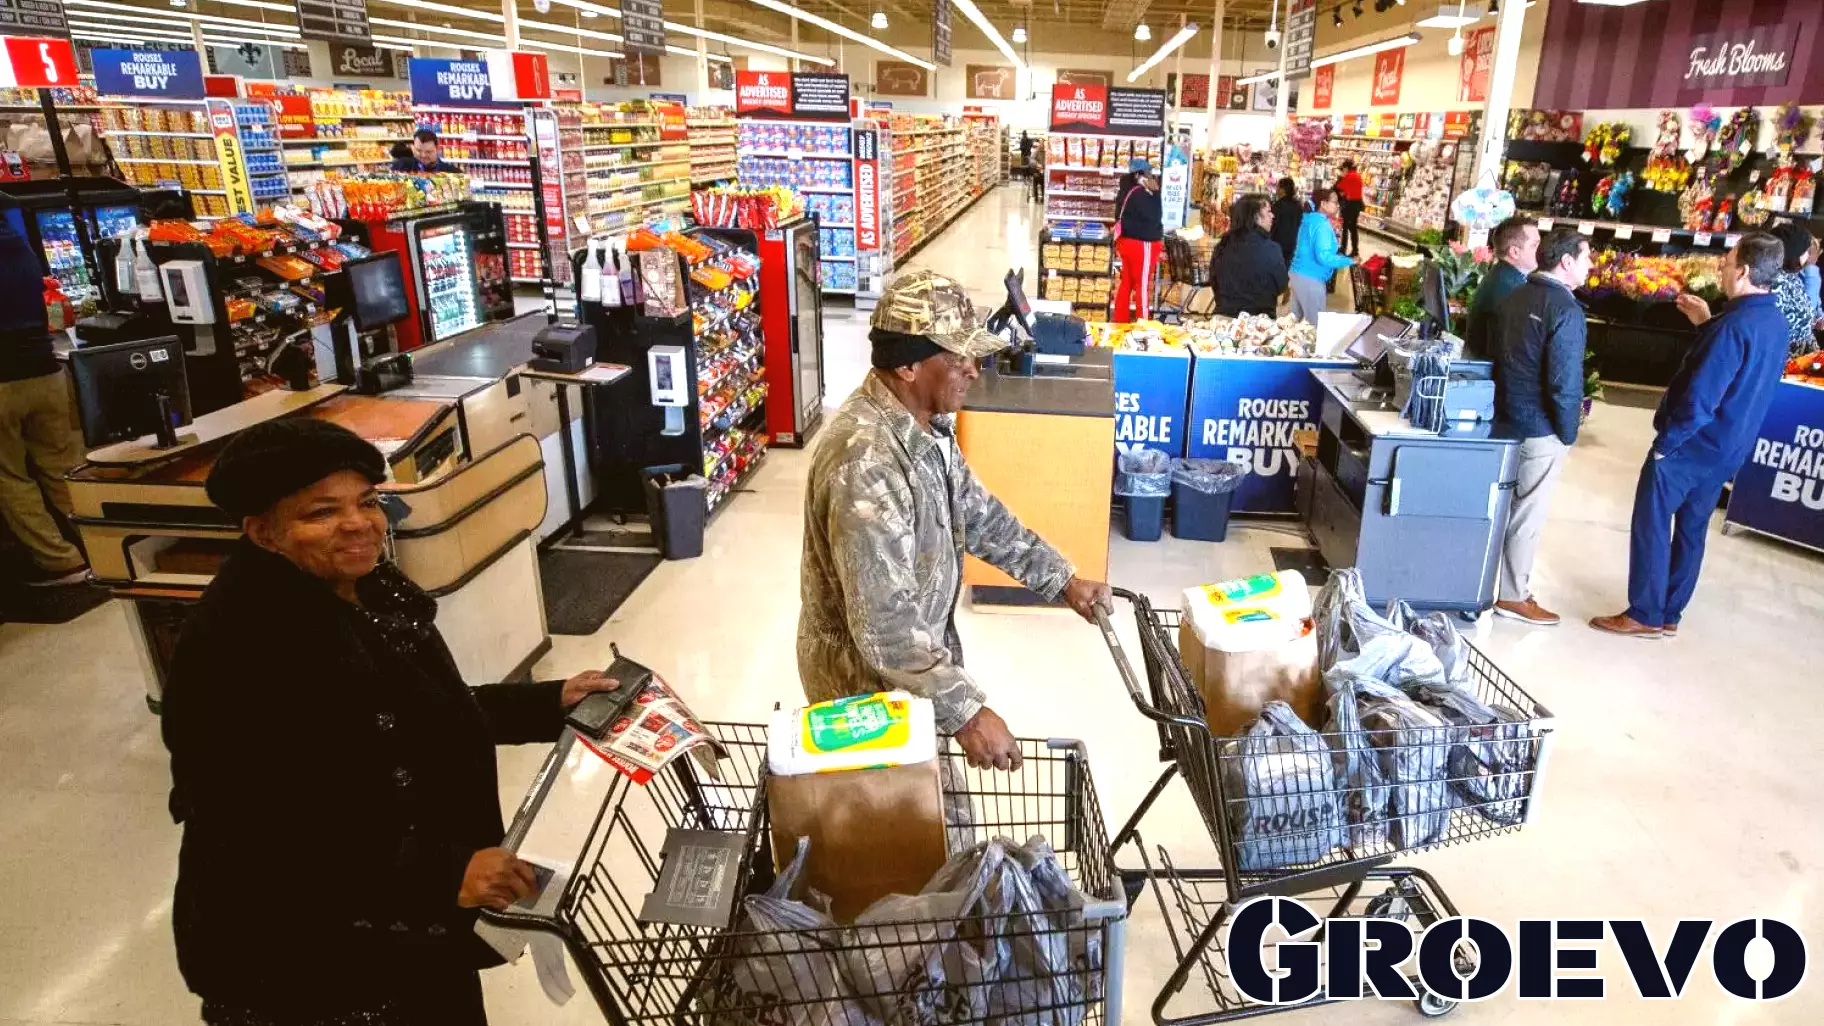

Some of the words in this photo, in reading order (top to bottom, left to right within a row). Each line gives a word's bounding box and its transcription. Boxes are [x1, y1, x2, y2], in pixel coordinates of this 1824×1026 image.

[38, 42, 58, 83] 5
[133, 53, 163, 63] ROUSES
[340, 46, 384, 72] Local
[1685, 41, 1728, 79] Fresh
[1728, 39, 1785, 76] Blooms
[120, 62, 177, 76] REMARKABLE
[450, 62, 480, 72] ROUSES
[134, 76, 169, 90] BUY
[436, 71, 490, 86] REMARKABL
[758, 74, 769, 85] AS
[449, 84, 484, 100] BUY
[740, 86, 788, 99] ADVERTISED
[1074, 88, 1085, 99] AS
[1055, 99, 1103, 112] ADVERTISED
[223, 138, 241, 185] VALUE
[234, 189, 247, 212] EST
[859, 164, 875, 230] ADVERTISED
[861, 231, 875, 245] AS
[1238, 398, 1309, 420] ROUSES
[1794, 424, 1824, 448] RO
[1226, 448, 1300, 477] BUY
